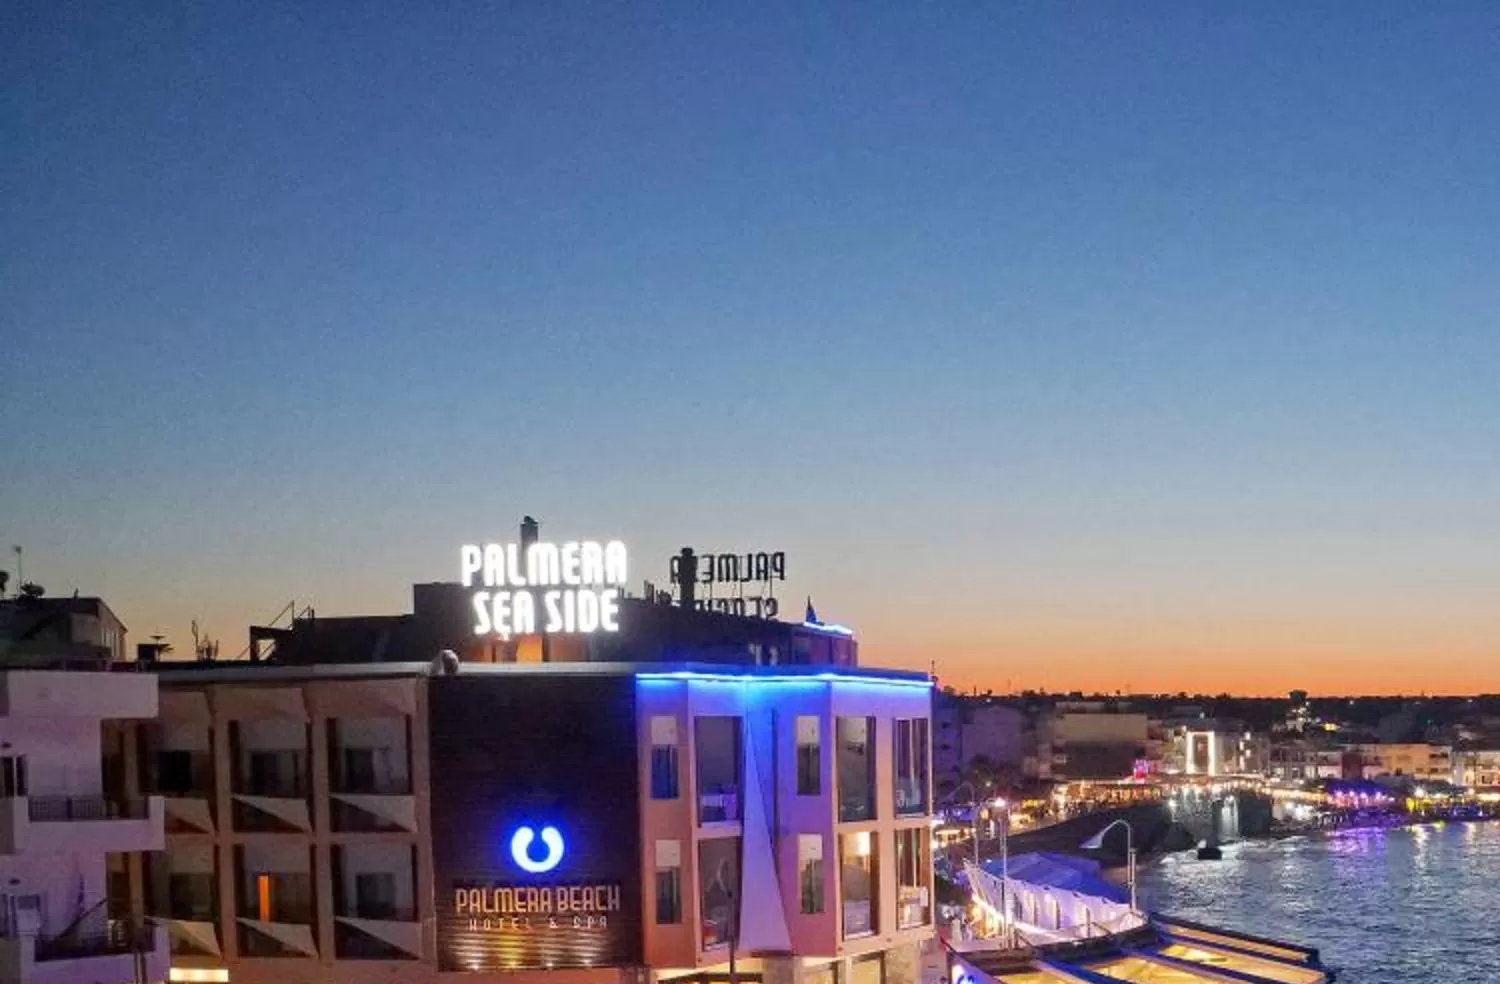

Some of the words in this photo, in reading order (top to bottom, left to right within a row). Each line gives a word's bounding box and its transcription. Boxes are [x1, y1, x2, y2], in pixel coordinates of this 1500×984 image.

[461, 540, 627, 586] PALMERA
[473, 589, 535, 634] SEA
[544, 588, 620, 633] SIDE
[455, 887, 551, 913] PALMERA
[557, 885, 620, 911] BEACH
[468, 917, 530, 931] HOTEL
[549, 917, 559, 929] &
[573, 916, 608, 929] SPA
